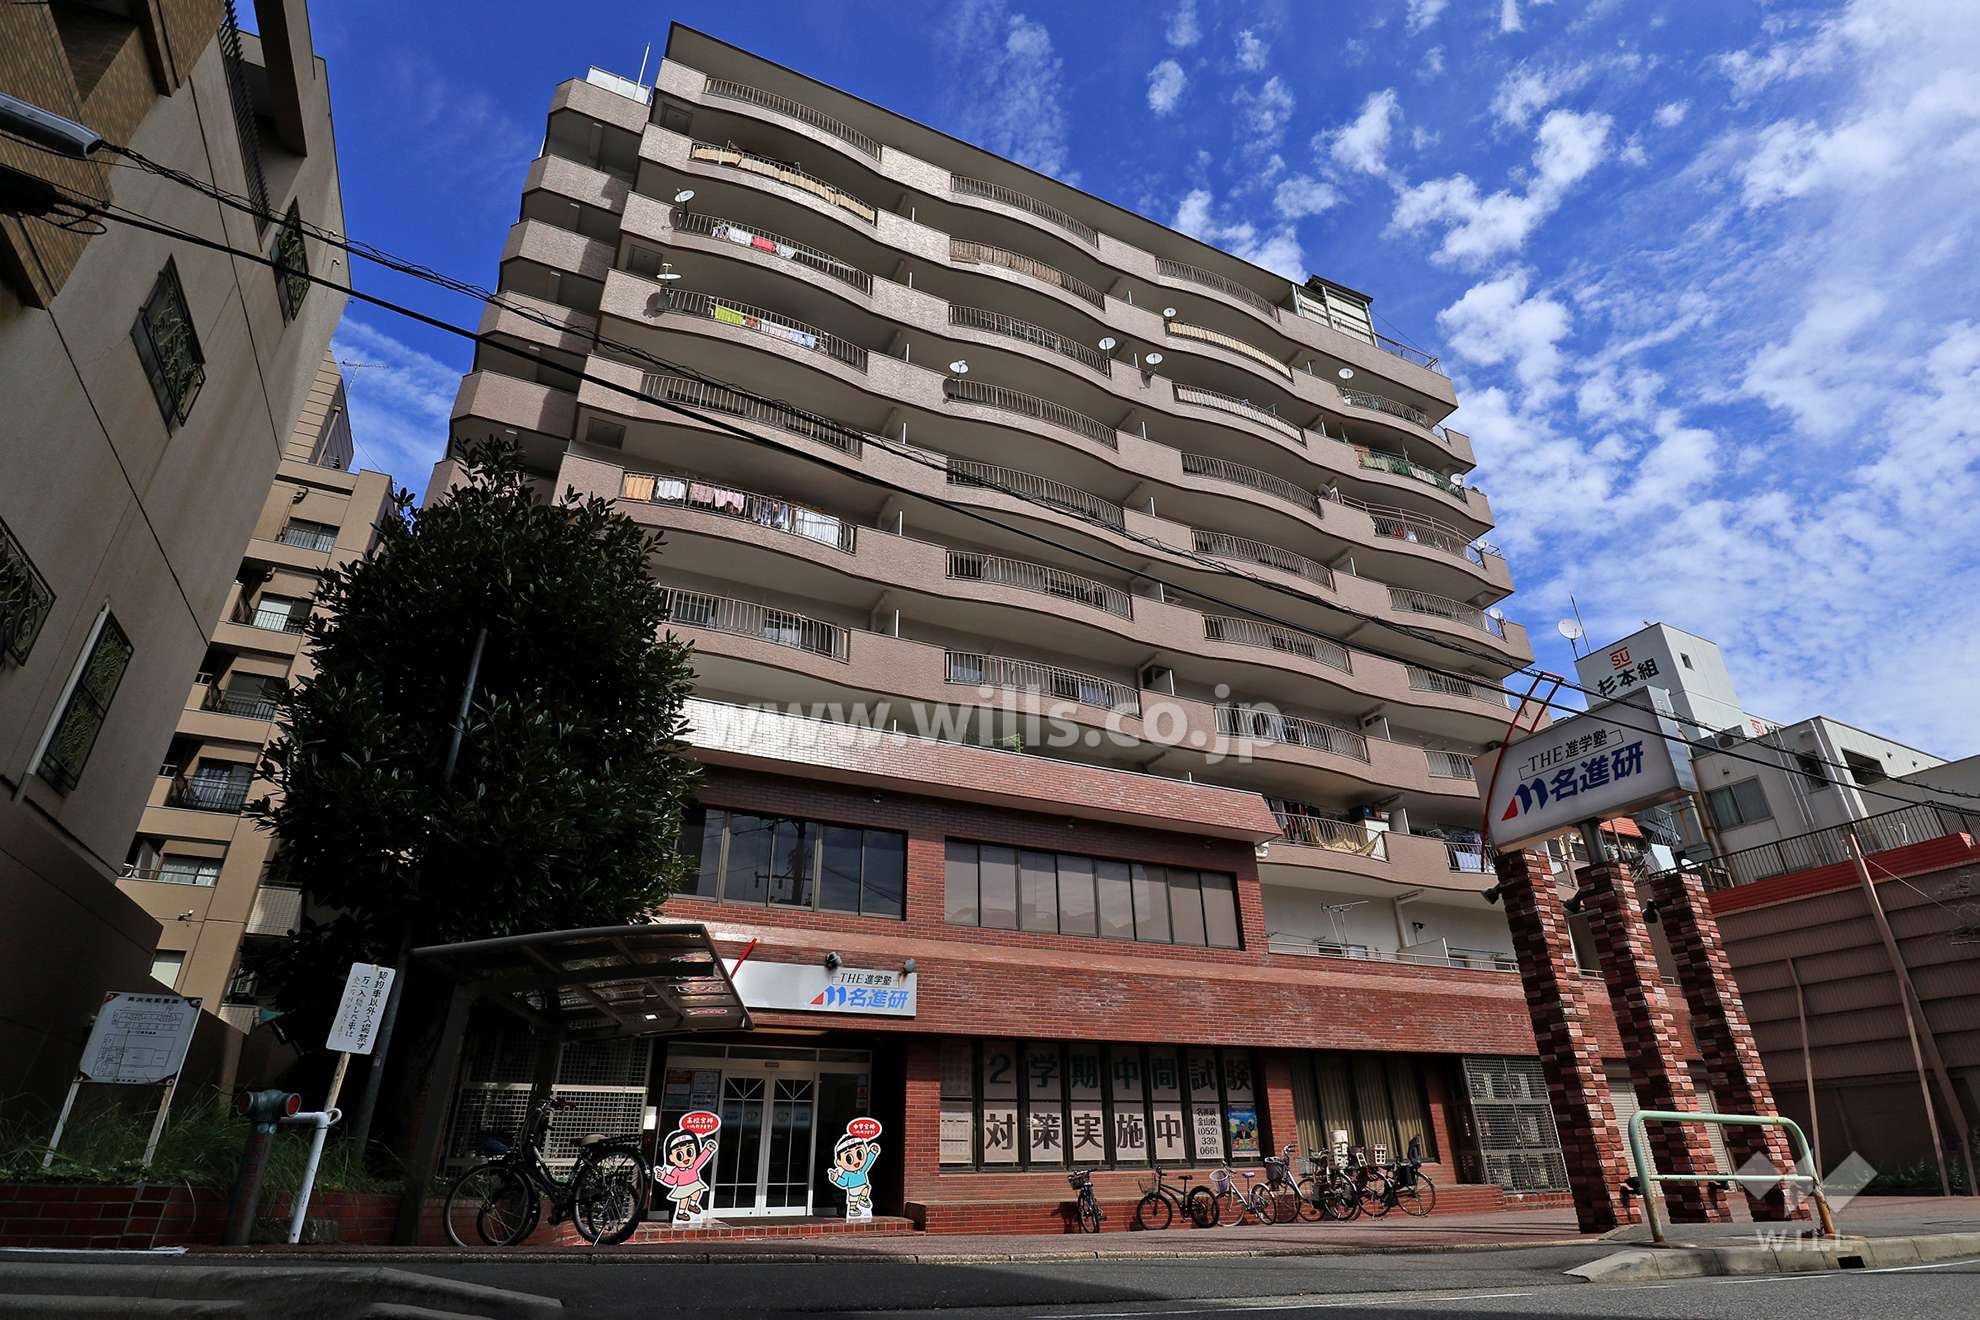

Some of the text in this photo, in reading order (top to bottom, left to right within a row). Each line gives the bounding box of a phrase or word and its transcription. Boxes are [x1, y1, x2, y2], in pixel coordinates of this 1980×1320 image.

[1611, 649, 1631, 667] SU
[1597, 657, 1660, 697] 杉本組
[1528, 729, 1608, 772] THE 進学塾
[1549, 740, 1644, 801] 名進研
[840, 972, 892, 986] THE 進学塾
[847, 987, 909, 1009] 名進研
[985, 1112, 1182, 1151] 対策実施中
[1198, 1127, 1218, 1136] (052)
[1201, 1136, 1216, 1145] 339
